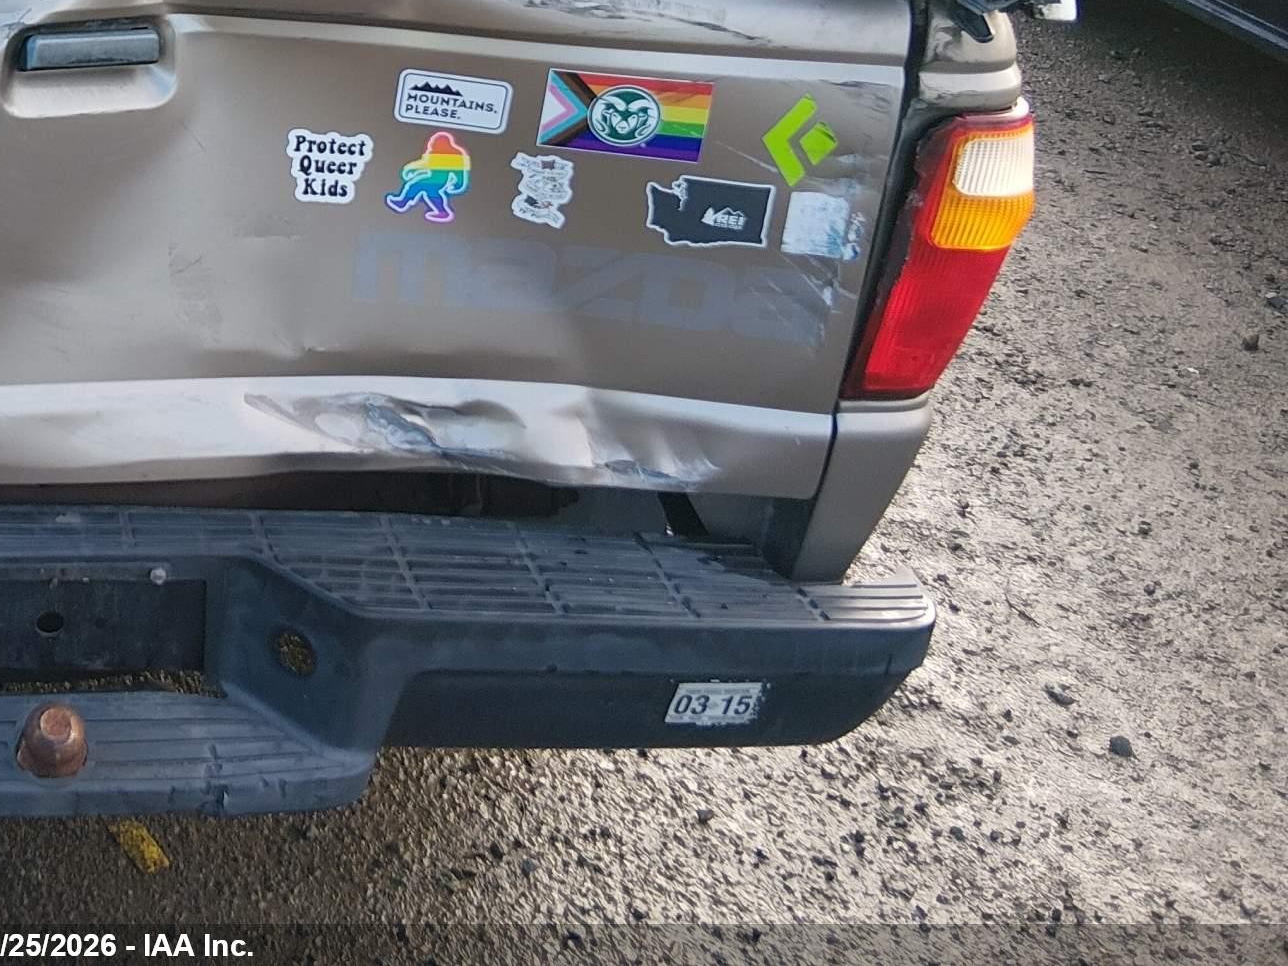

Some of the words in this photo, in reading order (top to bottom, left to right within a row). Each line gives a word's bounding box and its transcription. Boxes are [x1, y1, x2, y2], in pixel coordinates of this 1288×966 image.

[405, 103, 461, 120] PLEASE.
[407, 93, 497, 114] MOUNTAINS.
[293, 135, 366, 156] Protect
[298, 155, 357, 176] Queer
[302, 178, 348, 197] Kids
[674, 695, 710, 715] 03
[721, 695, 753, 715] 15
